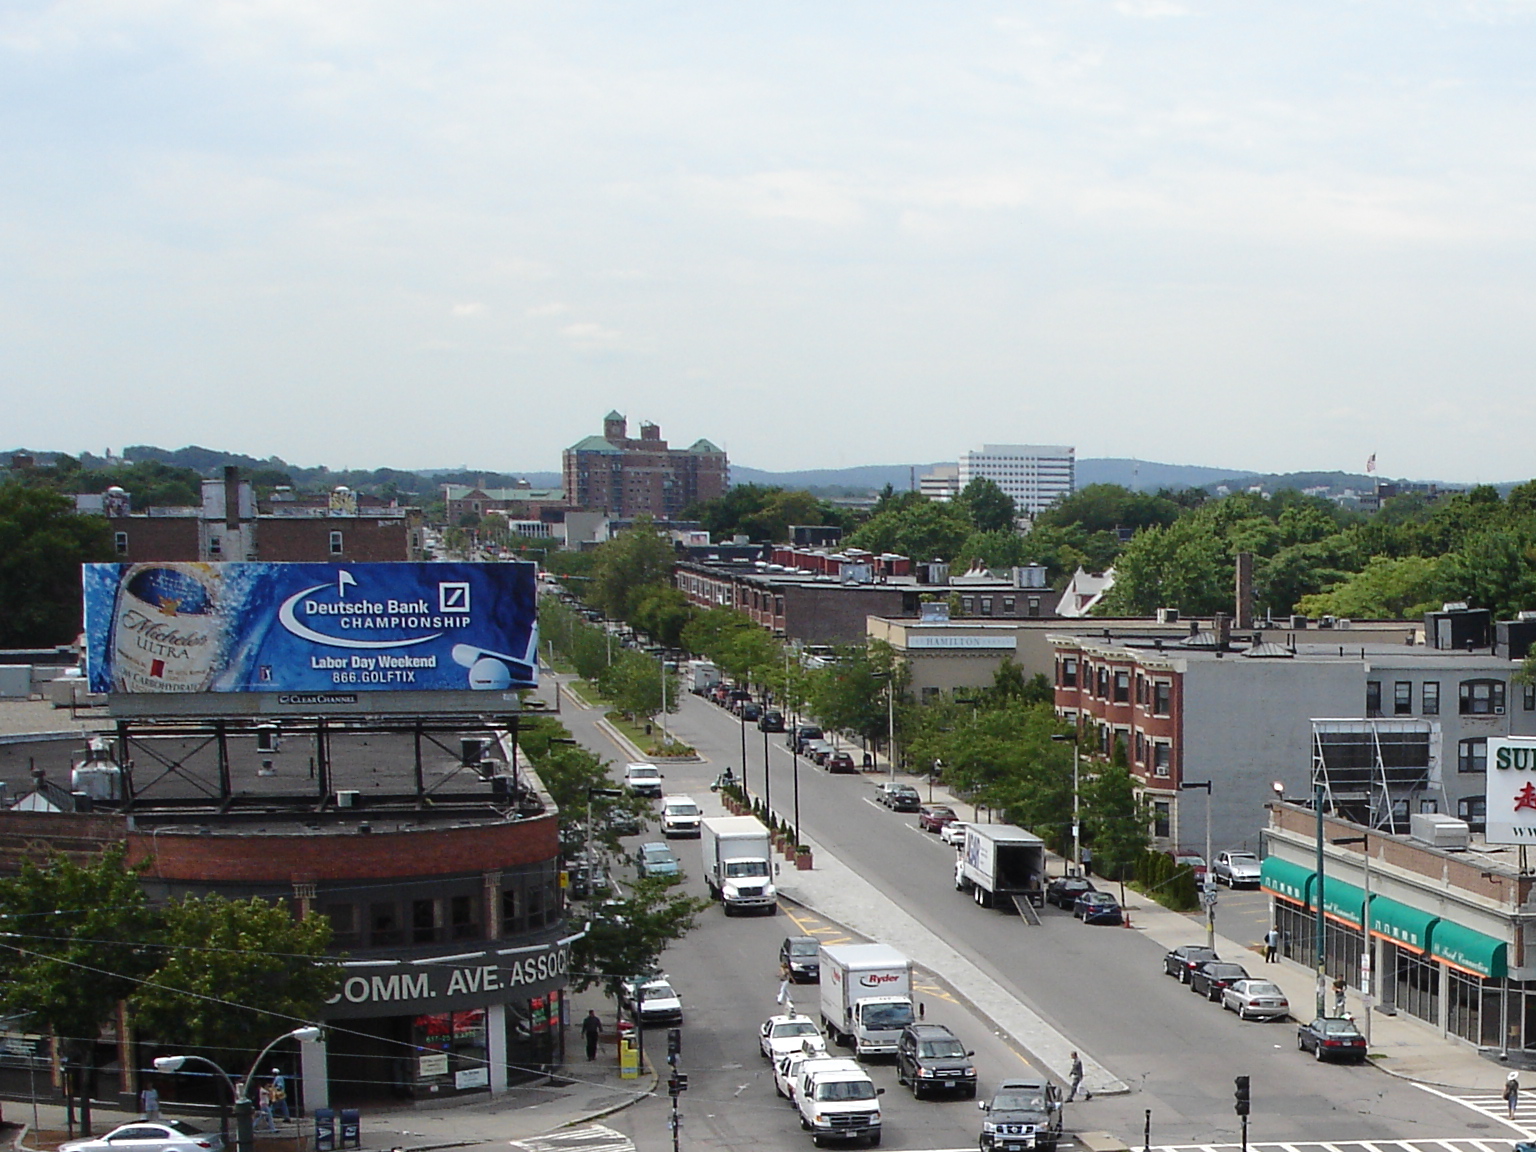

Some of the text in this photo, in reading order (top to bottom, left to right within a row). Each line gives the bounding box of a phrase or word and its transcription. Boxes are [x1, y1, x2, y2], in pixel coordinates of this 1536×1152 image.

[305, 599, 429, 615] Deutsche Bank
[340, 616, 471, 629] CHAMPIONSHIP
[136, 637, 190, 660] ULTRA
[311, 655, 437, 671] Labor Day Weekend
[332, 670, 416, 684] 866.GOLFTIX
[447, 964, 504, 996] AVE.
[869, 974, 900, 984] Ryder
